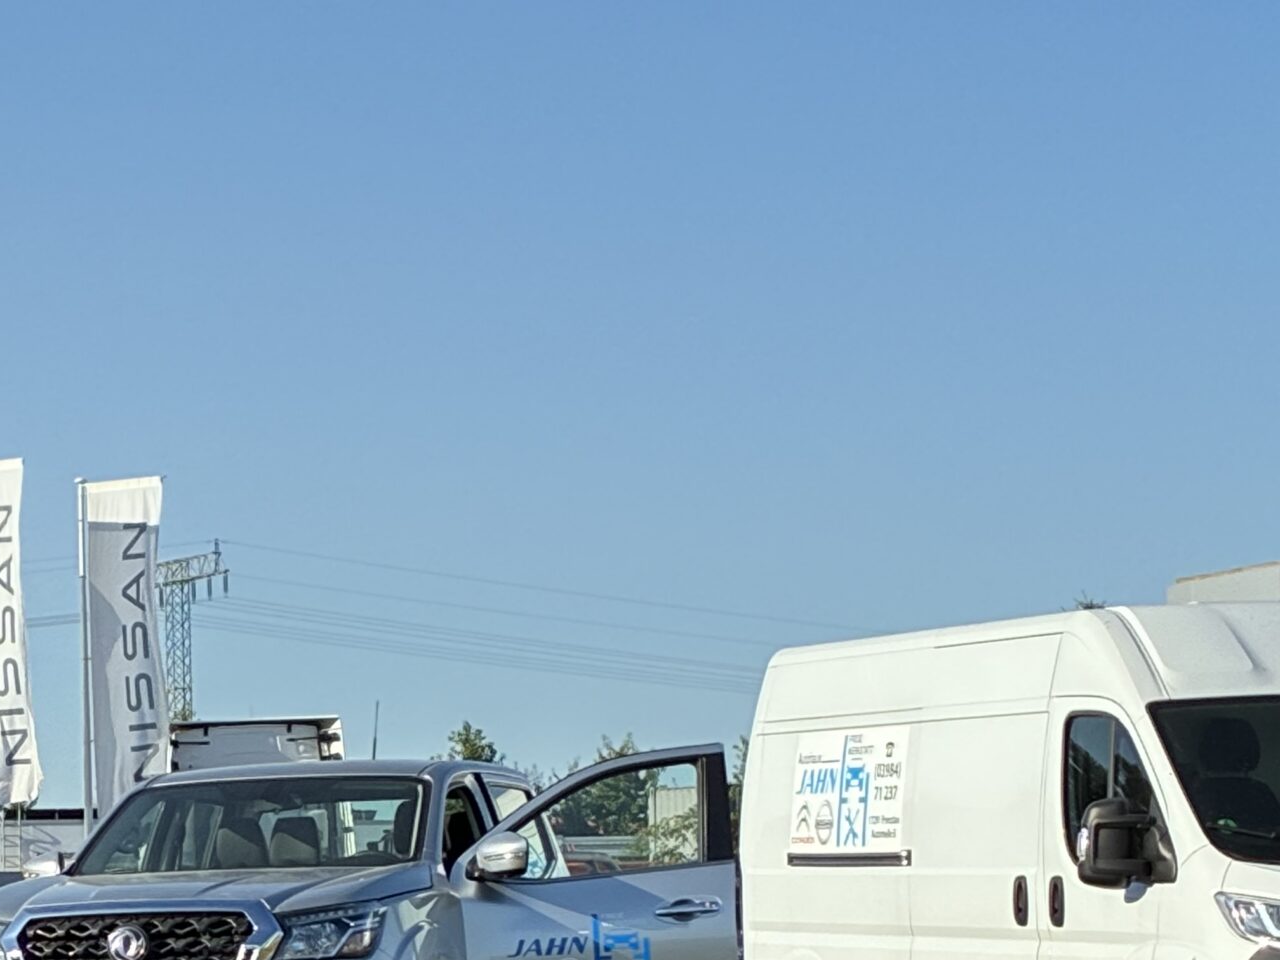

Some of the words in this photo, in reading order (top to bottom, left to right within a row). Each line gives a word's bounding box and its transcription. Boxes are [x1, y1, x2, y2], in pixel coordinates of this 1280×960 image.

[121, 522, 159, 783] NISSAN
[795, 768, 838, 794] JAHN
[507, 936, 589, 958] JAHN
